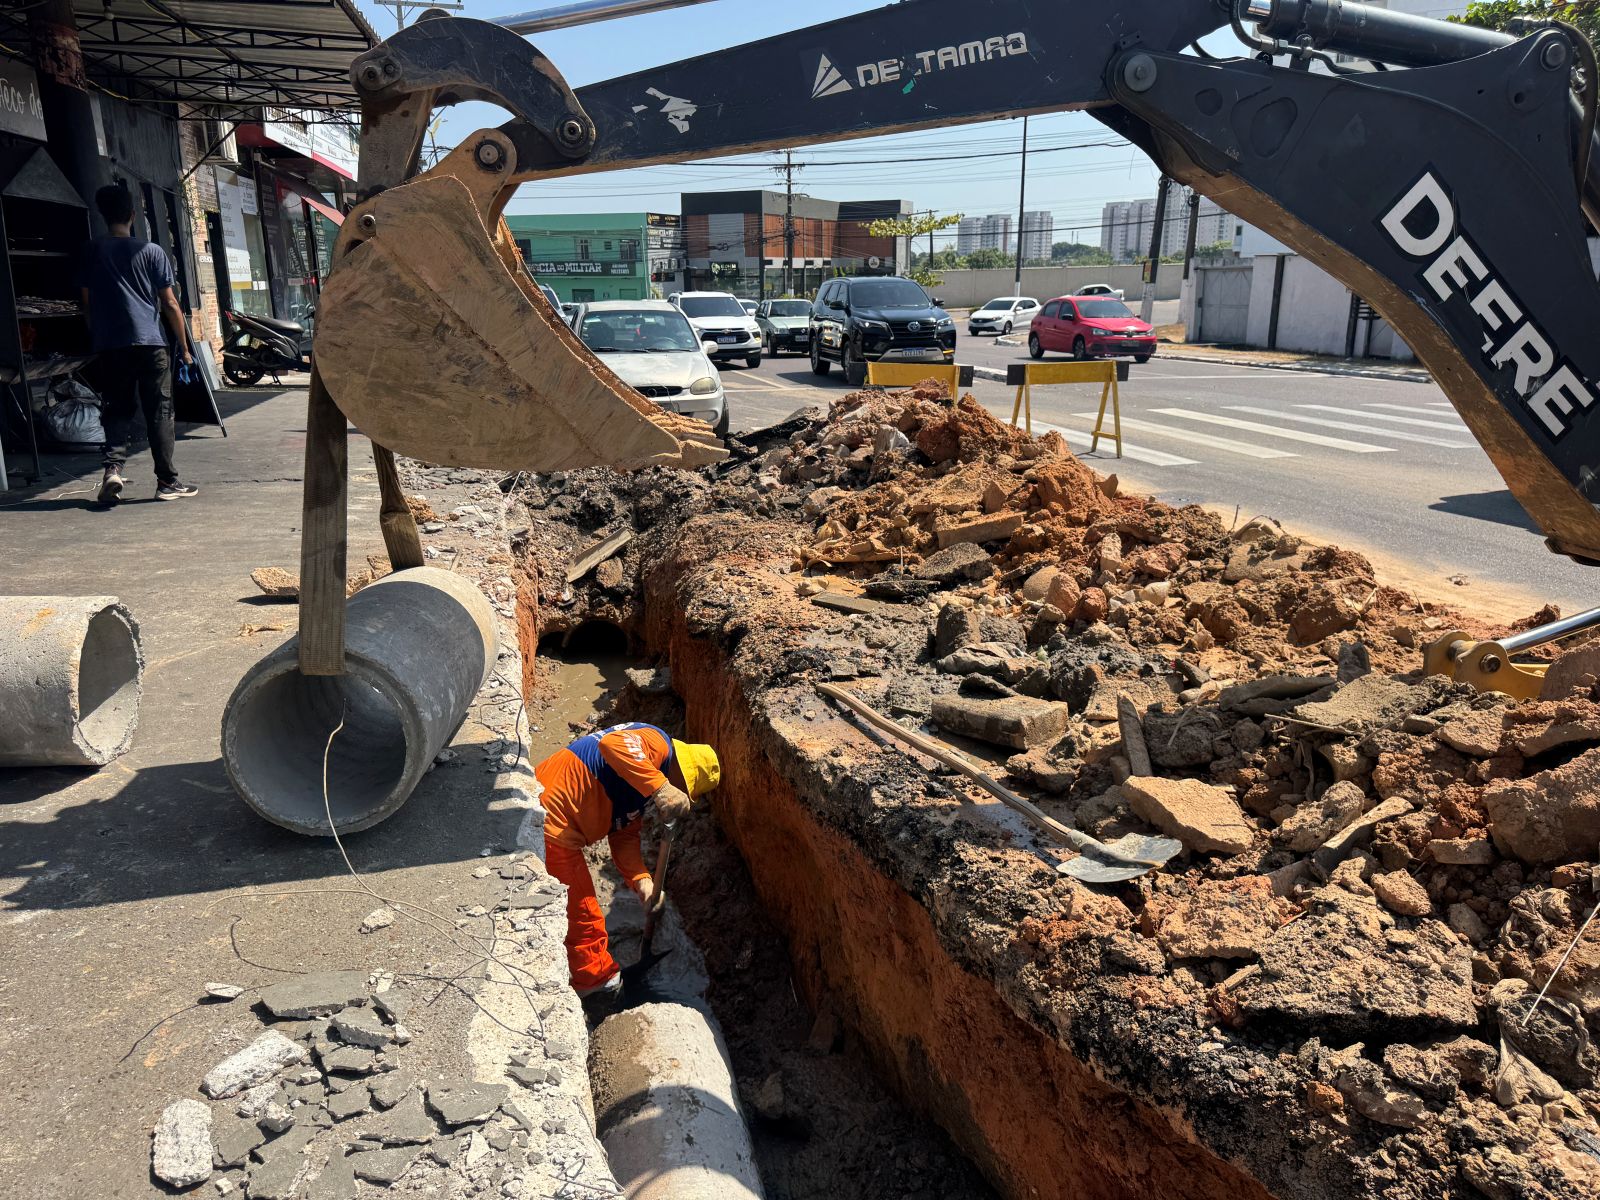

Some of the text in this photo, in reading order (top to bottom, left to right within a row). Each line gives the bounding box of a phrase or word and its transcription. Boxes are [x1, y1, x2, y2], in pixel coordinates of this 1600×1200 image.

[856, 32, 1028, 88] DETAMAQ
[565, 262, 602, 273] MILITAR
[1381, 172, 1595, 437] DEERE
